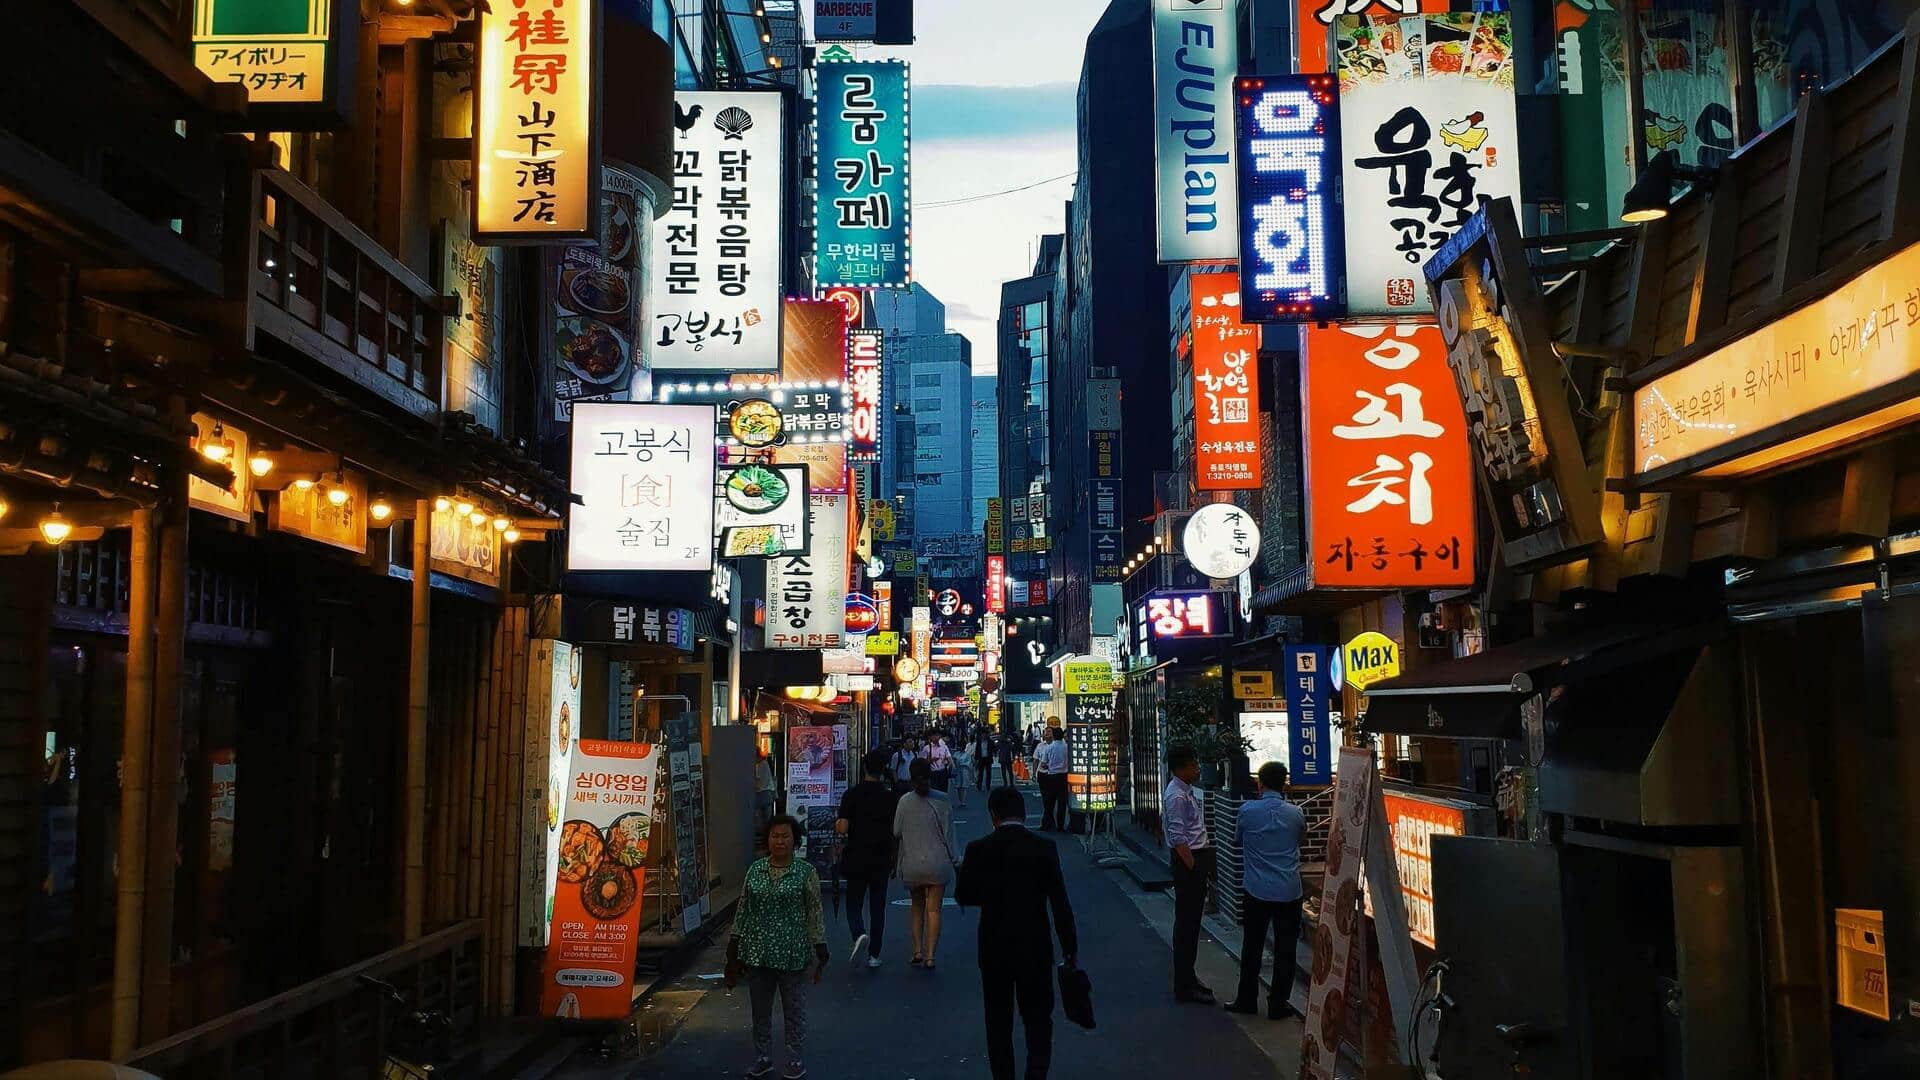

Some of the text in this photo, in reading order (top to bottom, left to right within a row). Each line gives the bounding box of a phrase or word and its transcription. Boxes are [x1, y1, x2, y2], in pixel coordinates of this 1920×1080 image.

[816, 2, 873, 17] BARBECUE
[838, 21, 853, 32] 4F
[208, 47, 306, 66] アイボリー
[504, 0, 570, 96] 桂冠
[1170, 20, 1230, 235] EJUplan
[512, 101, 557, 223] 山下酒店
[1250, 90, 1327, 297] 육회
[716, 149, 752, 297] 닭볶음탕
[826, 242, 897, 262] 무한리필
[837, 262, 887, 280] 셀프바
[656, 311, 743, 352] 고봉식
[1744, 344, 1807, 405] 육사시미
[782, 412, 842, 432] 닭볶음탕
[594, 427, 692, 463] 고봉식
[616, 517, 670, 547] 술집
[684, 546, 700, 558] 2F
[1326, 536, 1461, 573] 자동구이
[782, 555, 814, 629] 소곱창
[773, 634, 840, 648] 구이전문
[1350, 645, 1393, 672] Max
[1299, 676, 1318, 775] 테스트메이트
[575, 771, 648, 792] 심야영업
[573, 791, 647, 807] 새벽 3시까지
[561, 922, 629, 932] OPEN AM 11:00
[561, 931, 626, 941] CLOSE AM 3:00
